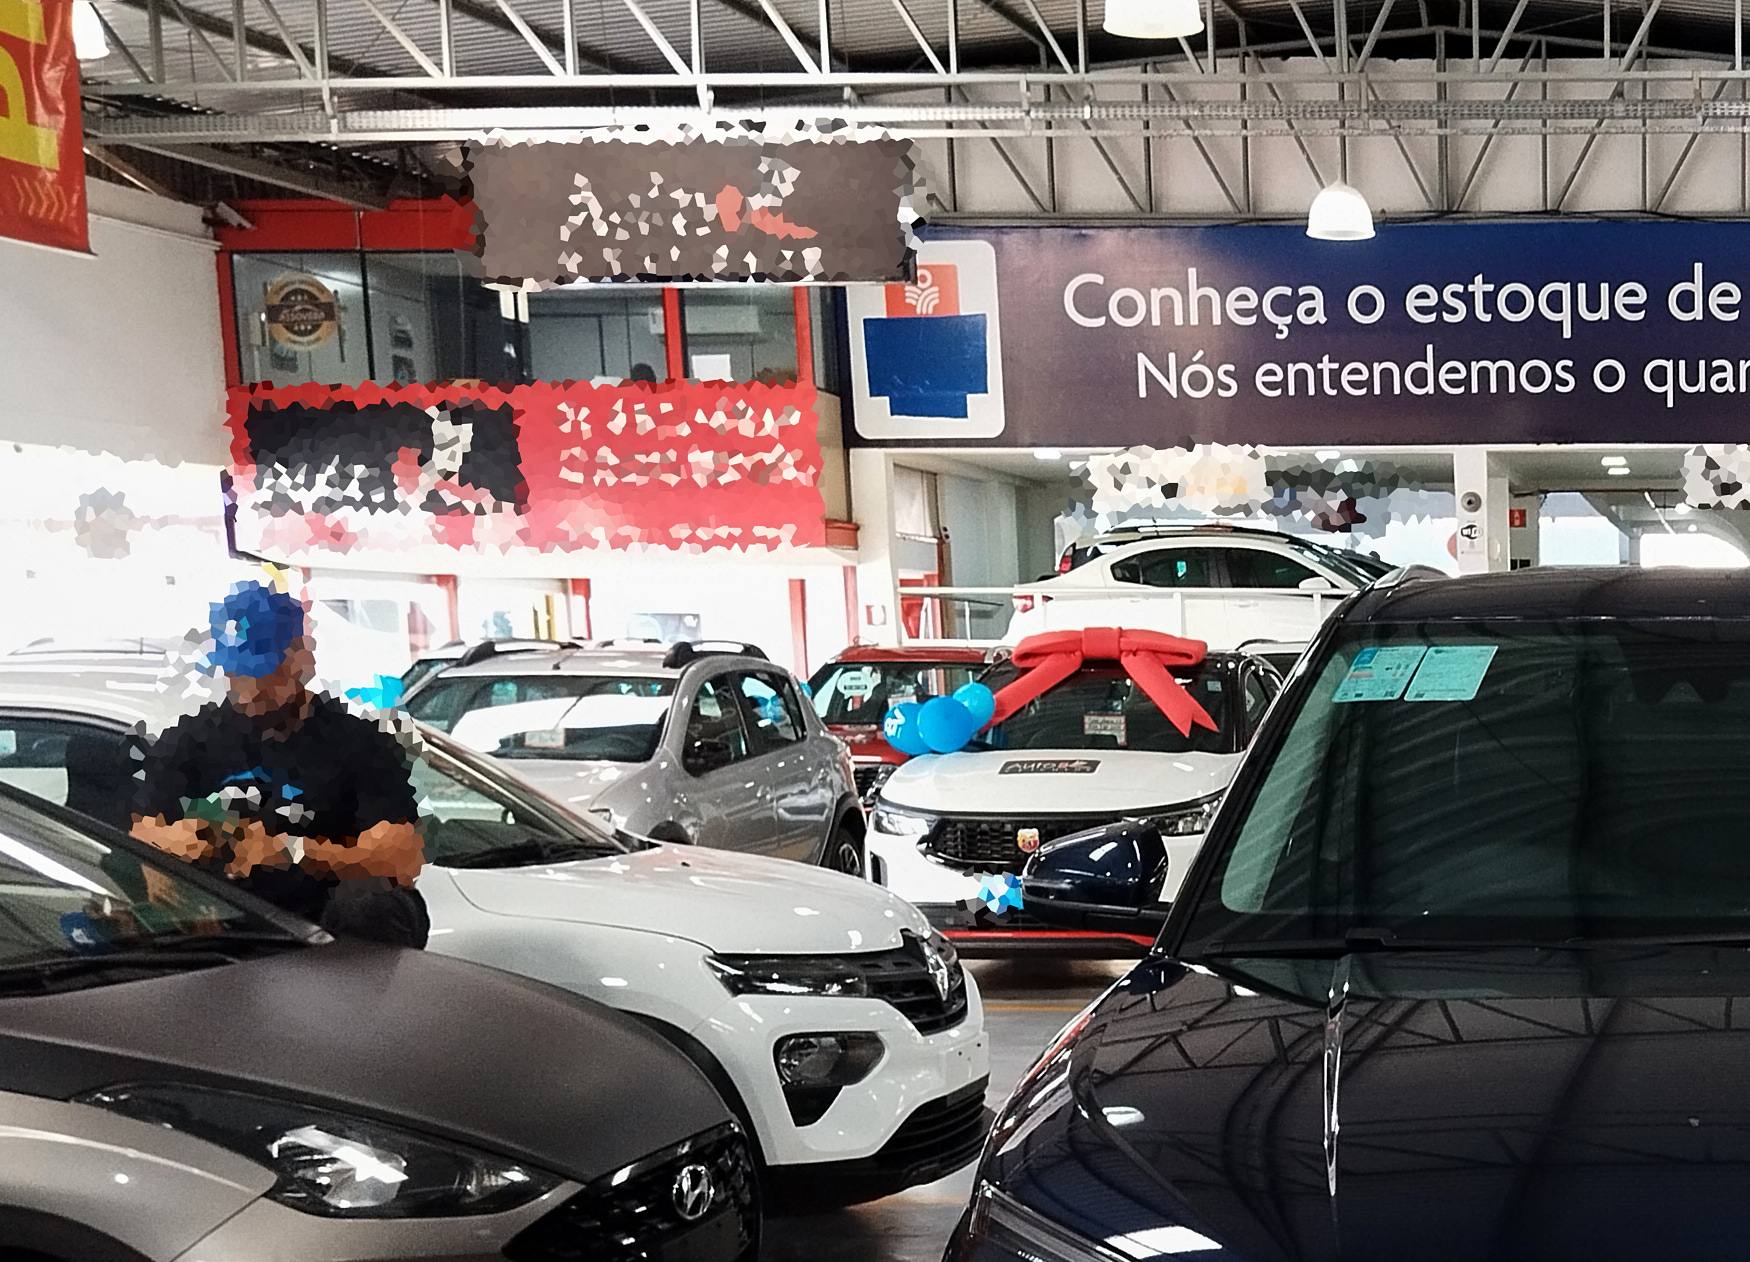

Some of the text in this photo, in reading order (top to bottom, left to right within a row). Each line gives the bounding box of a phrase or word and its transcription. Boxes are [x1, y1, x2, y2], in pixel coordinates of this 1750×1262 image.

[1063, 267, 1328, 339] Conheça
[1347, 284, 1385, 324] o
[1405, 273, 1648, 339] estoque
[1667, 262, 1742, 321] de
[1137, 349, 1239, 398] Nós
[1255, 344, 1576, 397] entendemos
[1593, 358, 1626, 393] o
